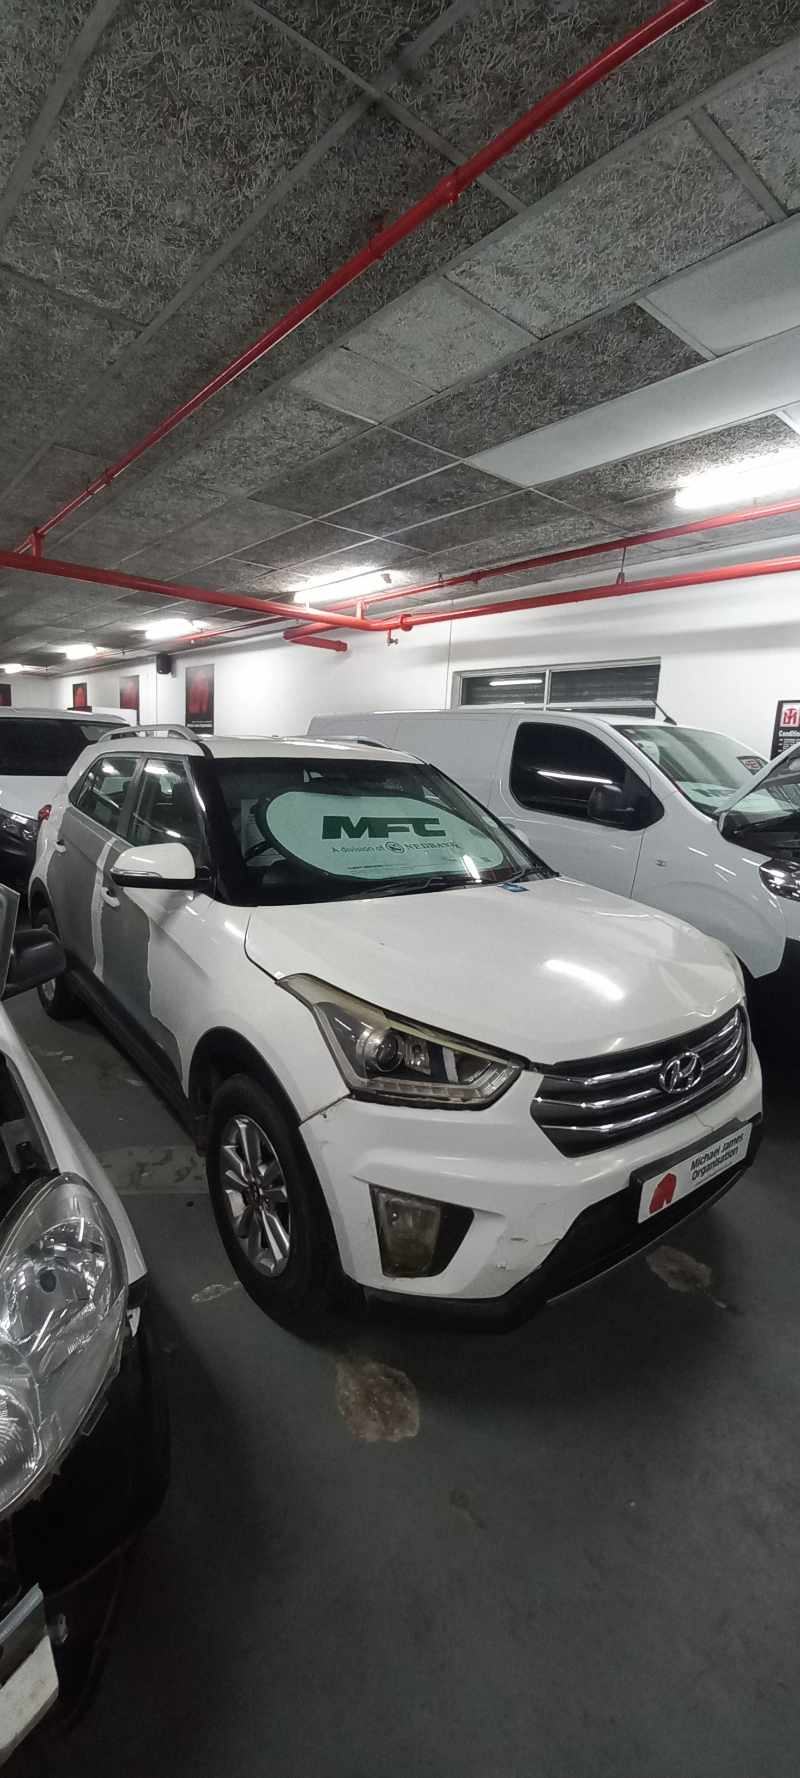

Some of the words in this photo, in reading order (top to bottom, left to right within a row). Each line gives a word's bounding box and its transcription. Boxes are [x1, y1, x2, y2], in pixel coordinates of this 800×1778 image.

[322, 816, 446, 839] MFC
[341, 844, 374, 854] division
[404, 841, 461, 851] NEDBANK
[690, 1145, 721, 1171] Michael
[721, 1133, 744, 1153] James
[691, 1148, 738, 1180] Organisation
